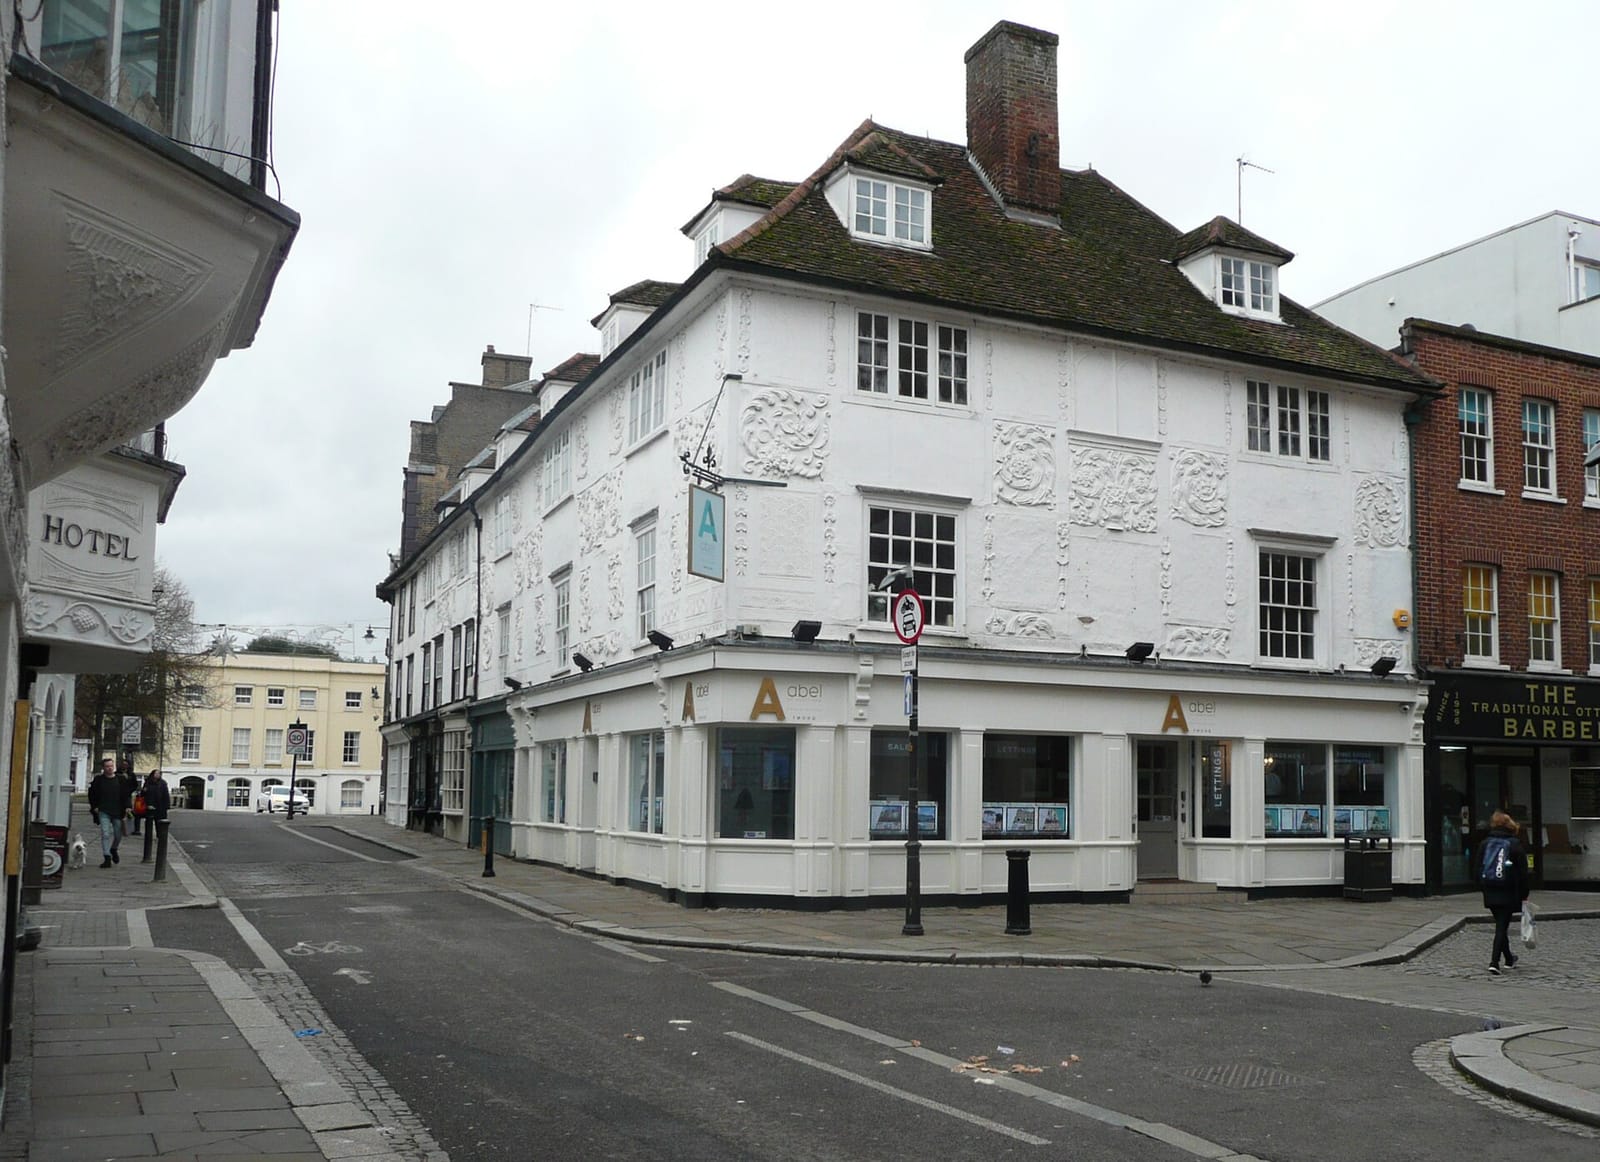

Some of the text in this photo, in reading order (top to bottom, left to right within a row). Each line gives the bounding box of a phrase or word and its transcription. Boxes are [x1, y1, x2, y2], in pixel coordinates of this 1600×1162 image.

[41, 514, 139, 561] HOTEL
[698, 499, 717, 542] A
[750, 677, 822, 720] A abel
[1161, 693, 1216, 733] A abel
[1472, 702, 1568, 716] TRADITIONAL
[1525, 684, 1576, 705] THE
[1504, 717, 1600, 739] BARBE
[1214, 750, 1222, 807] LETTINGS
